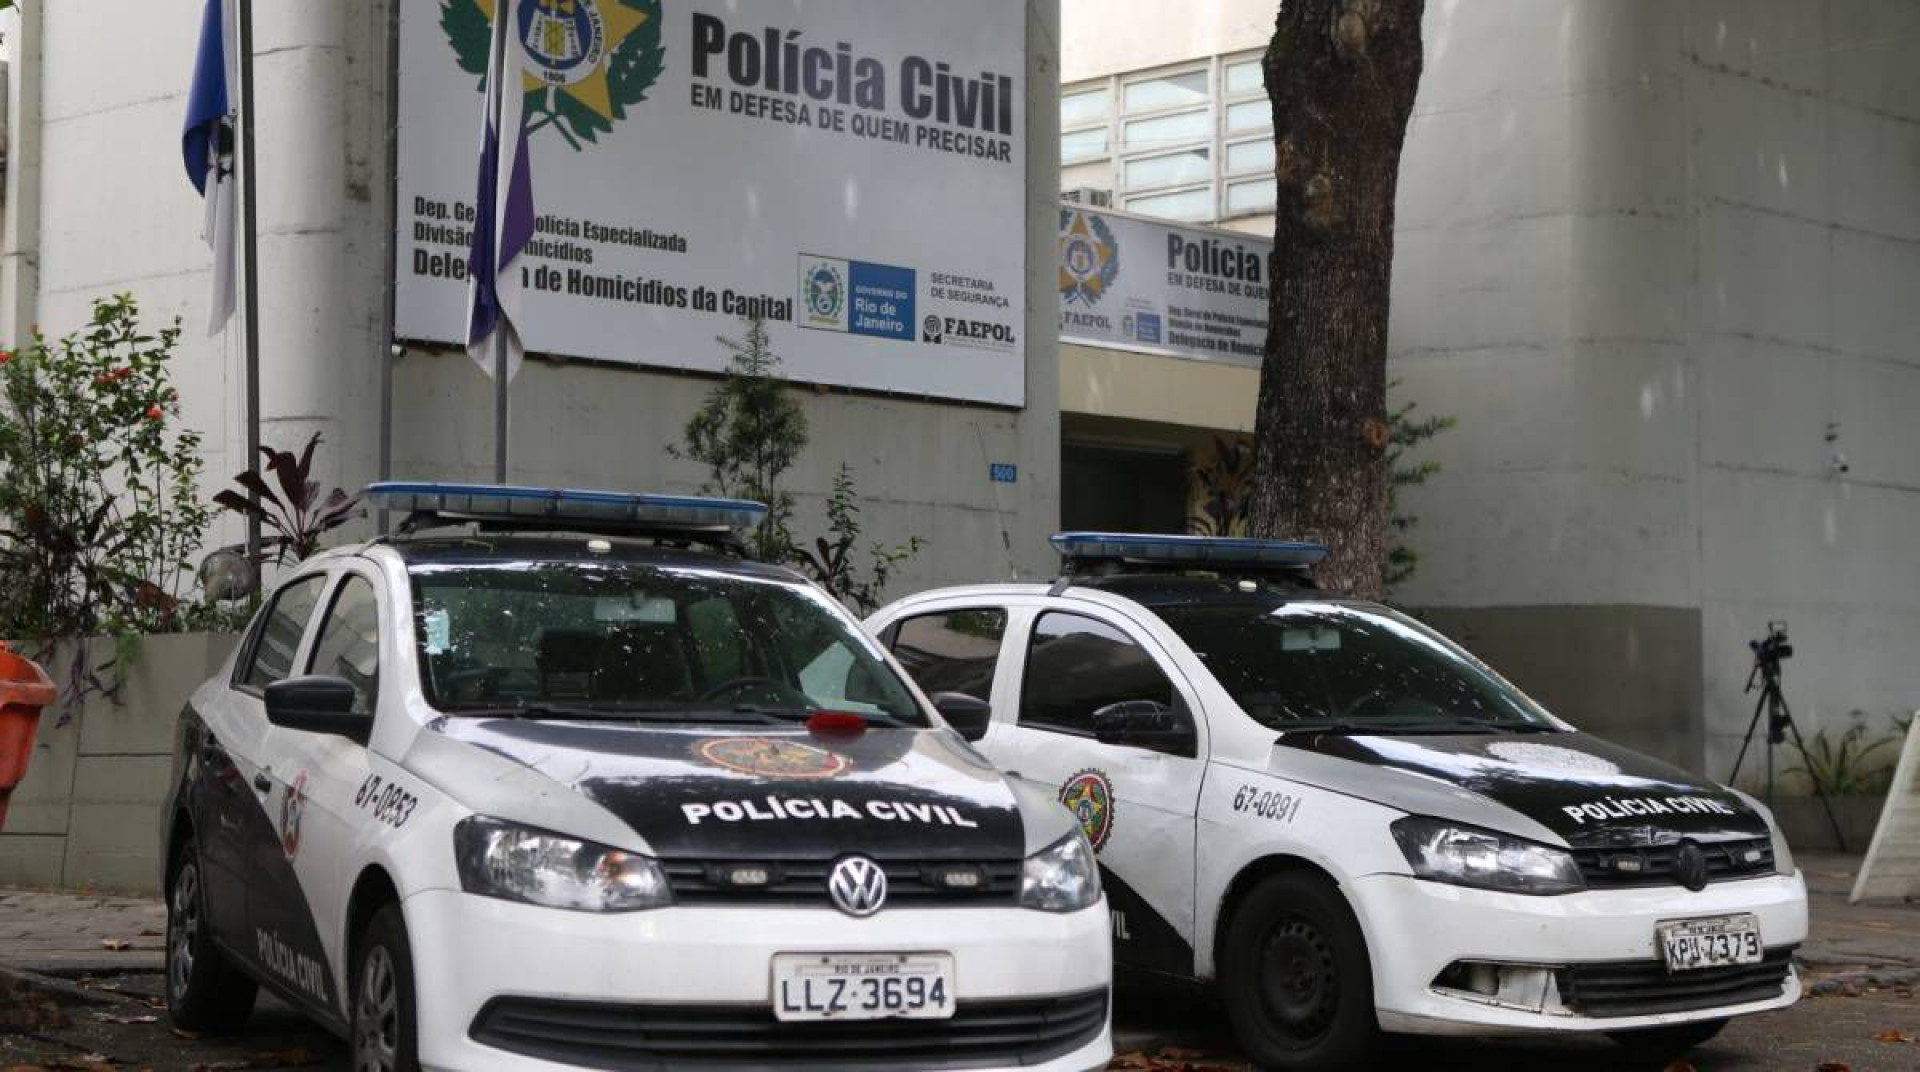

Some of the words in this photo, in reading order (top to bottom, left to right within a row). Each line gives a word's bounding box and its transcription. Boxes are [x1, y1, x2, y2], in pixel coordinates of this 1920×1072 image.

[692, 12, 886, 112] Polícia
[900, 55, 1012, 136] Civil
[691, 83, 722, 111] EM
[729, 90, 812, 128] DEFESA
[818, 106, 844, 132] DE
[852, 113, 909, 145] QUEM
[916, 126, 1012, 163] PRECISAR
[414, 195, 451, 221] Dep.
[535, 215, 580, 238] olícia
[583, 220, 688, 254] Especializada
[523, 238, 593, 265] micídios
[1167, 231, 1261, 284] Polícia
[535, 264, 562, 292] de
[567, 268, 689, 309] Homicídios
[692, 285, 718, 313] da
[722, 288, 793, 323] Capital
[930, 271, 995, 292] SECRETARIA
[1167, 271, 1183, 286] EM
[1185, 274, 1225, 295] DEFESA
[1228, 281, 1242, 297] DE
[855, 298, 878, 314] Rio
[879, 301, 897, 316] de
[930, 287, 945, 299] DE
[946, 289, 1010, 309] SEGURANÇA
[855, 315, 905, 333] Janeiro
[943, 316, 1016, 344] FAEPOL
[681, 794, 864, 826] POLÍCIA
[865, 800, 979, 829] CIVIL
[1233, 784, 1303, 825] 67-0891
[1561, 796, 1675, 825] POLÍCIA
[1665, 796, 1737, 816] CIVIL
[255, 927, 298, 987] POLÍCIA
[296, 951, 329, 1003] CIVIL
